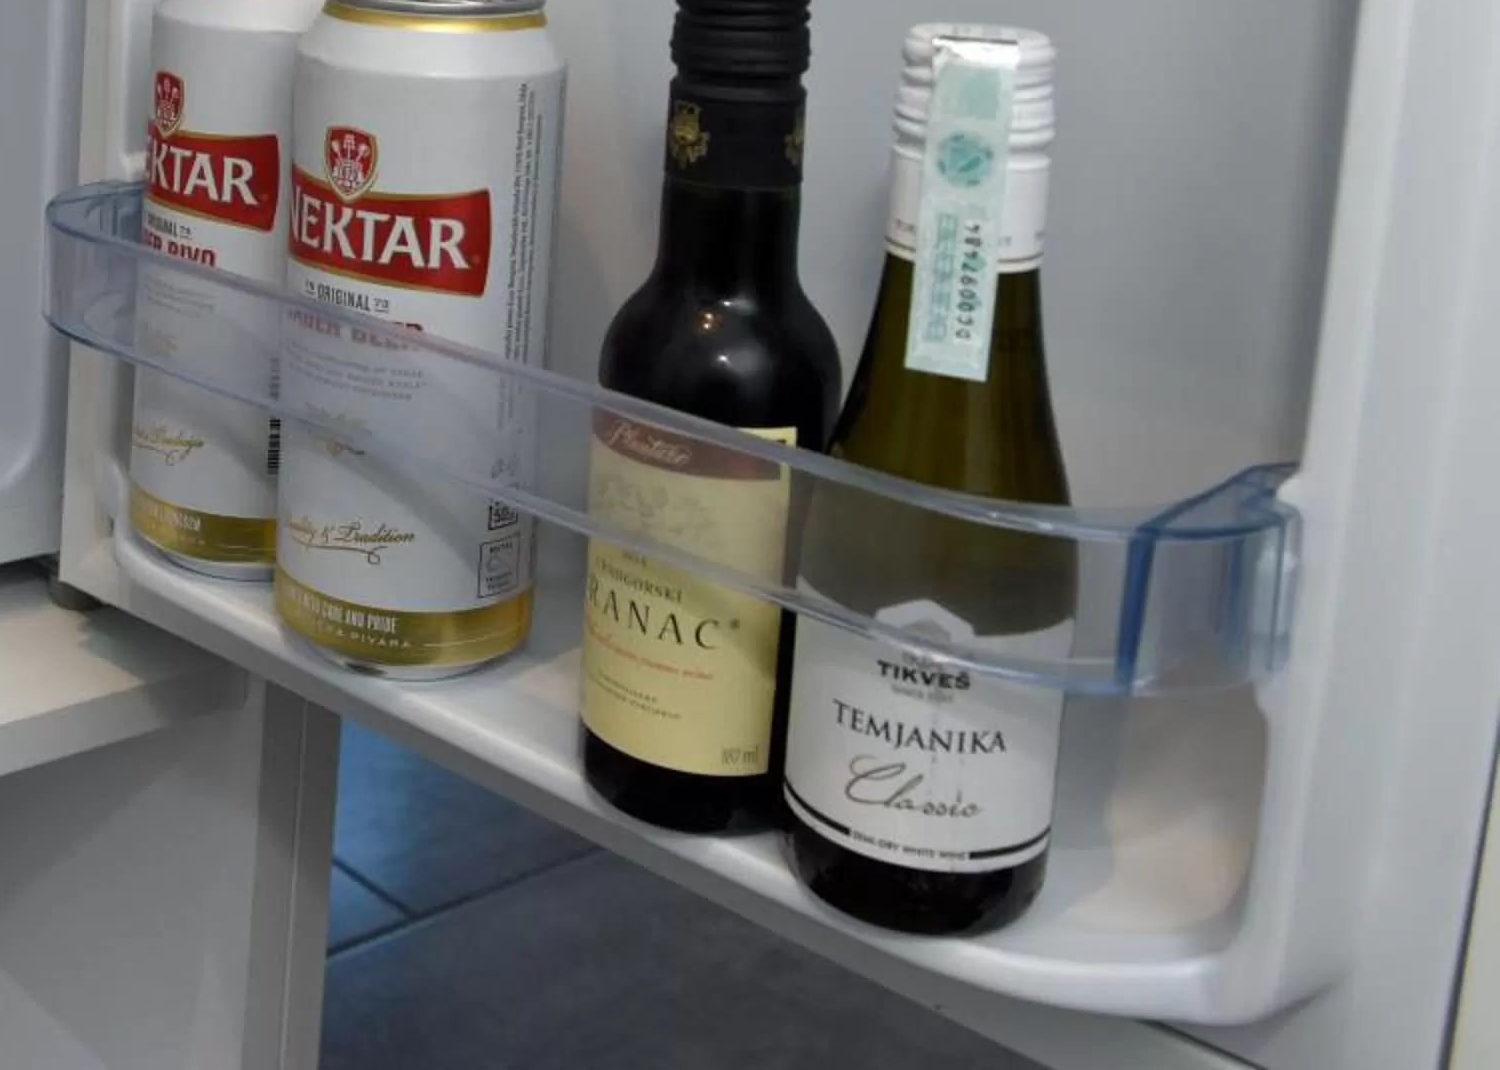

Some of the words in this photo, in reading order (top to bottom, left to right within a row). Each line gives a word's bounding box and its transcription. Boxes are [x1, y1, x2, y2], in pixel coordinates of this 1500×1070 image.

[290, 186, 471, 271] NEKTAR
[317, 284, 372, 312] ORIGINAL
[876, 659, 971, 691] TIKVEŠ
[832, 697, 1008, 755] TEMJANIKA
[844, 753, 984, 818] Classic
